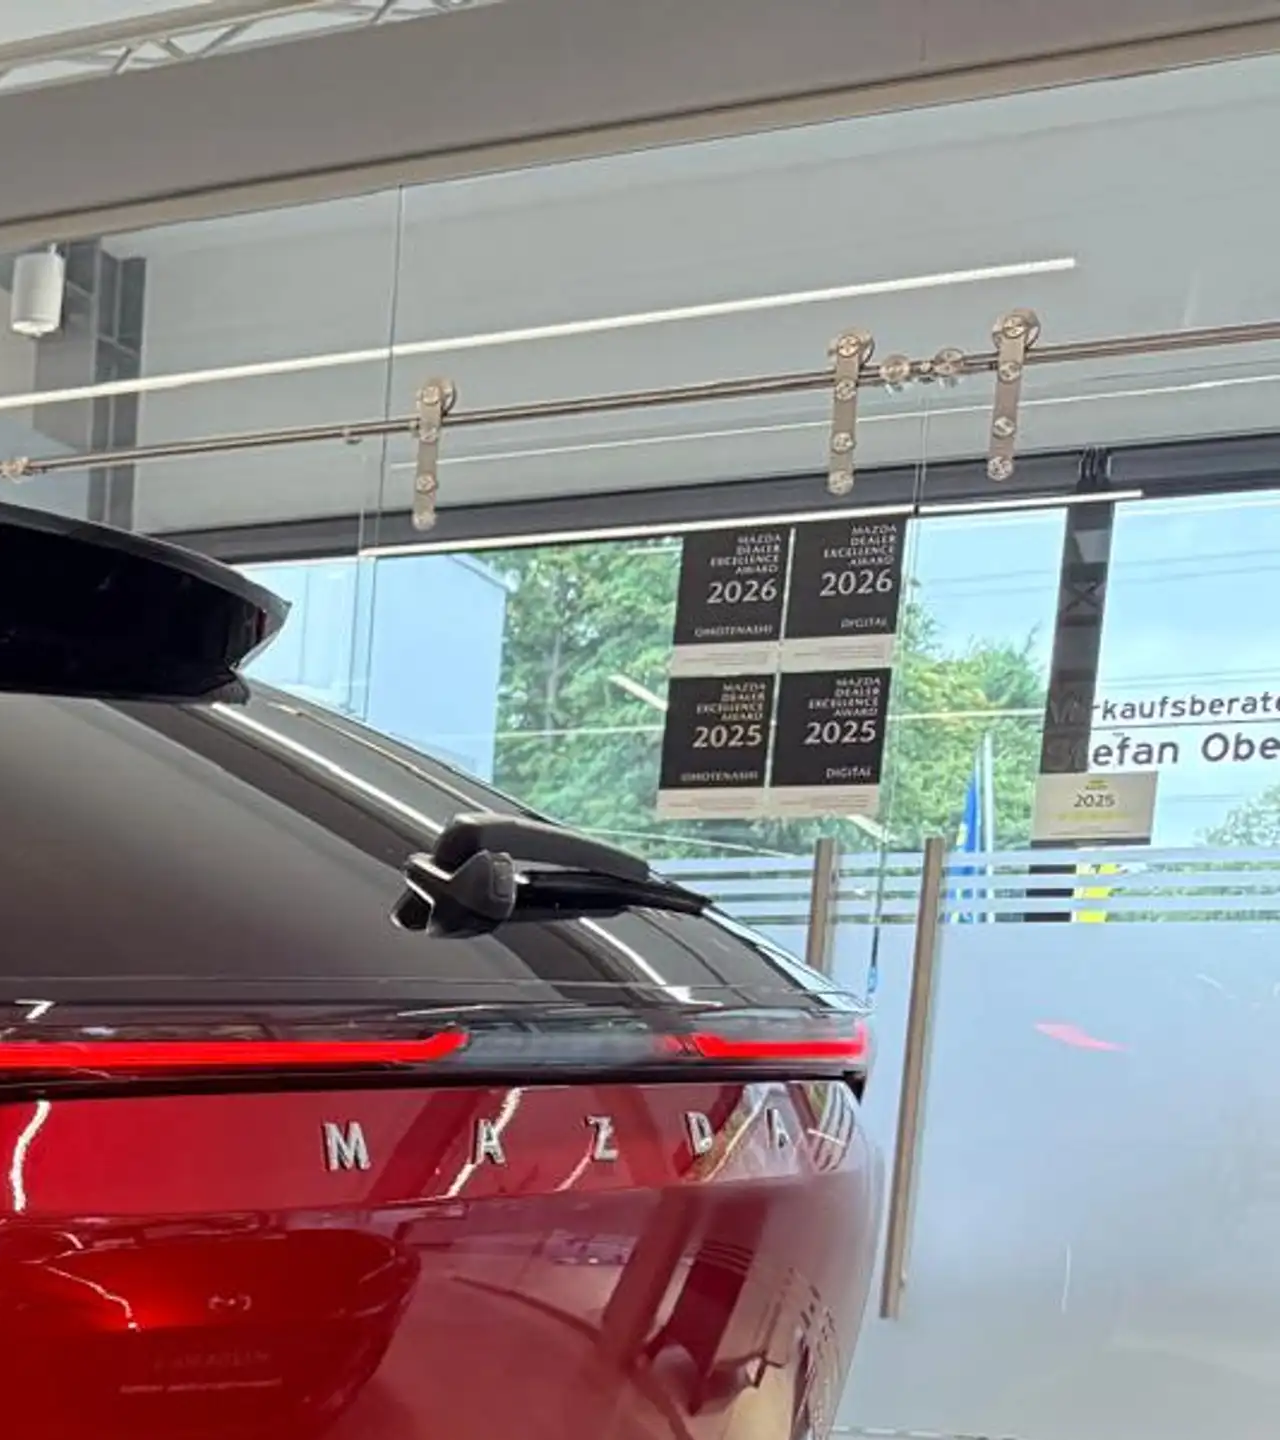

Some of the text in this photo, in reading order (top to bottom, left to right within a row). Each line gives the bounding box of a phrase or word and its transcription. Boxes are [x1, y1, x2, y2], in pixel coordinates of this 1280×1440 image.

[707, 577, 777, 604] 2026
[820, 568, 893, 597] 2026
[692, 723, 762, 748] 2025
[803, 719, 876, 745] 2025
[1201, 731, 1280, 762] Obe
[1073, 792, 1116, 808] 2025
[322, 1109, 791, 1172] MAZDA
